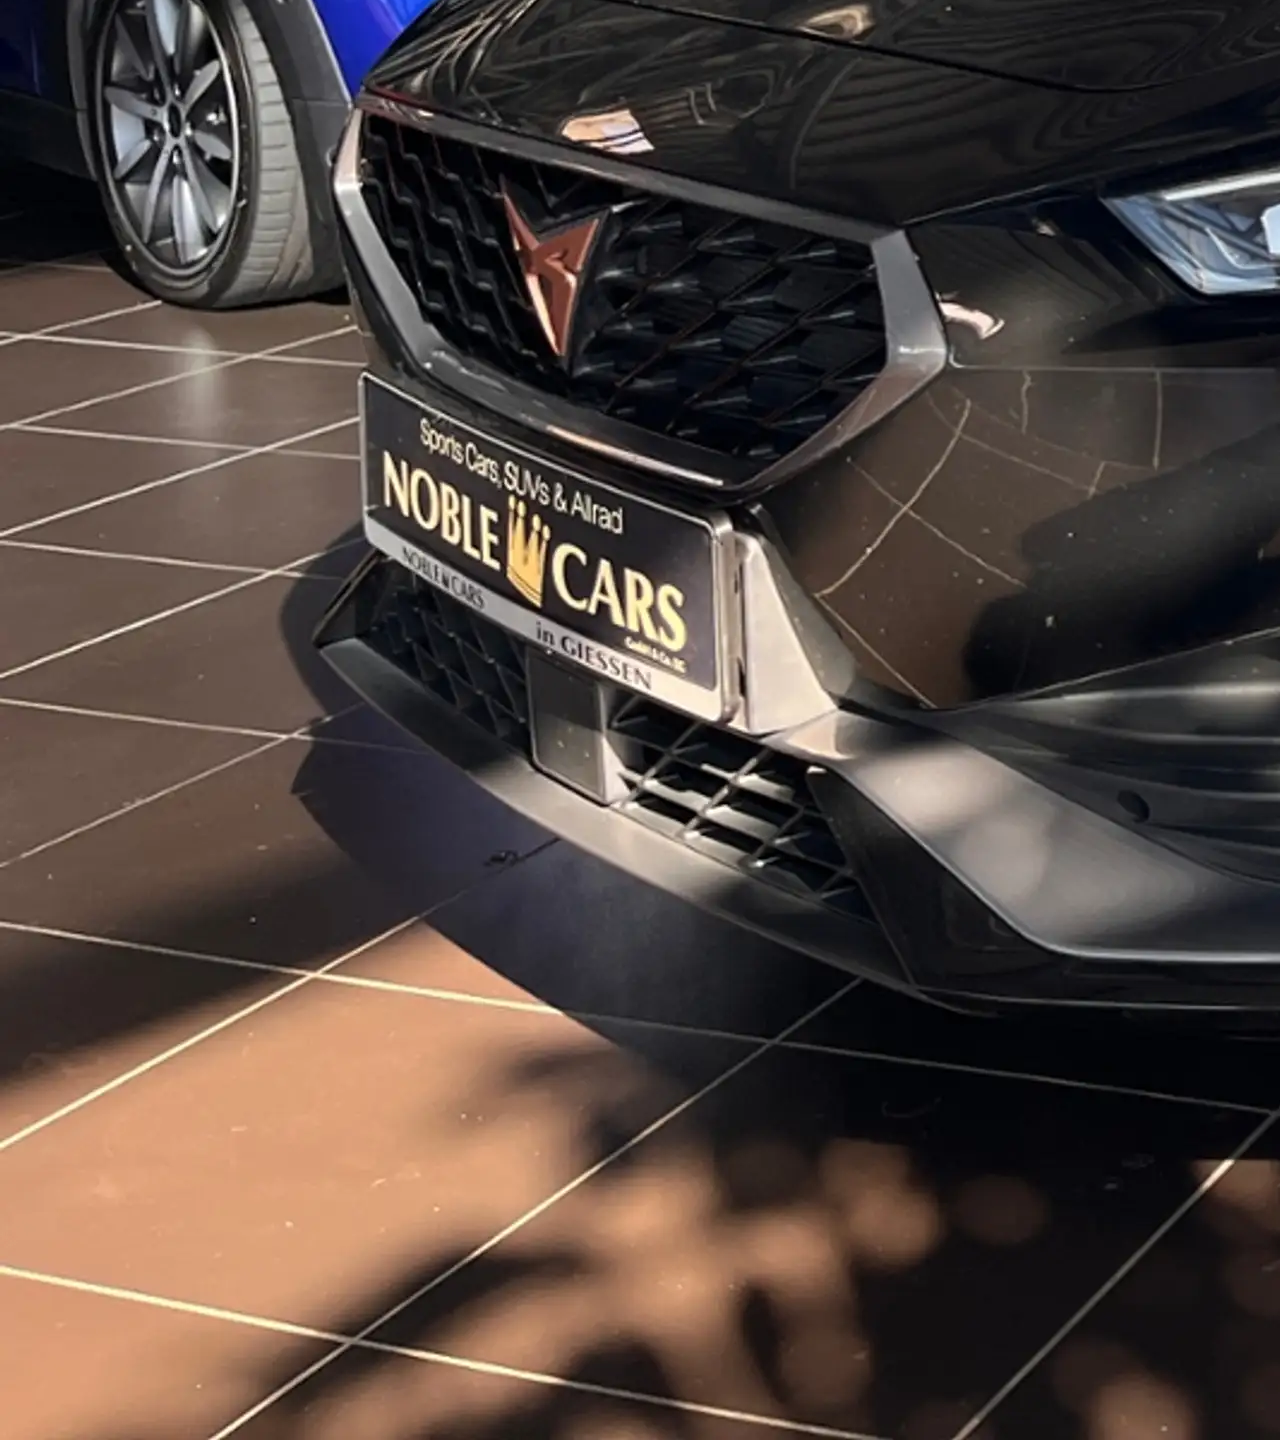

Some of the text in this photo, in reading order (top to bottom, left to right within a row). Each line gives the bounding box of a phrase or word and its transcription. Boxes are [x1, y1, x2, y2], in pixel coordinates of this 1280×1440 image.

[419, 417, 464, 465] Sports
[465, 441, 503, 489] Cars,
[553, 482, 568, 512] &
[570, 490, 624, 535] Allrad
[383, 450, 687, 653] NOBLE CARS
[535, 619, 556, 647] in
[560, 634, 653, 691] GIESSEN
